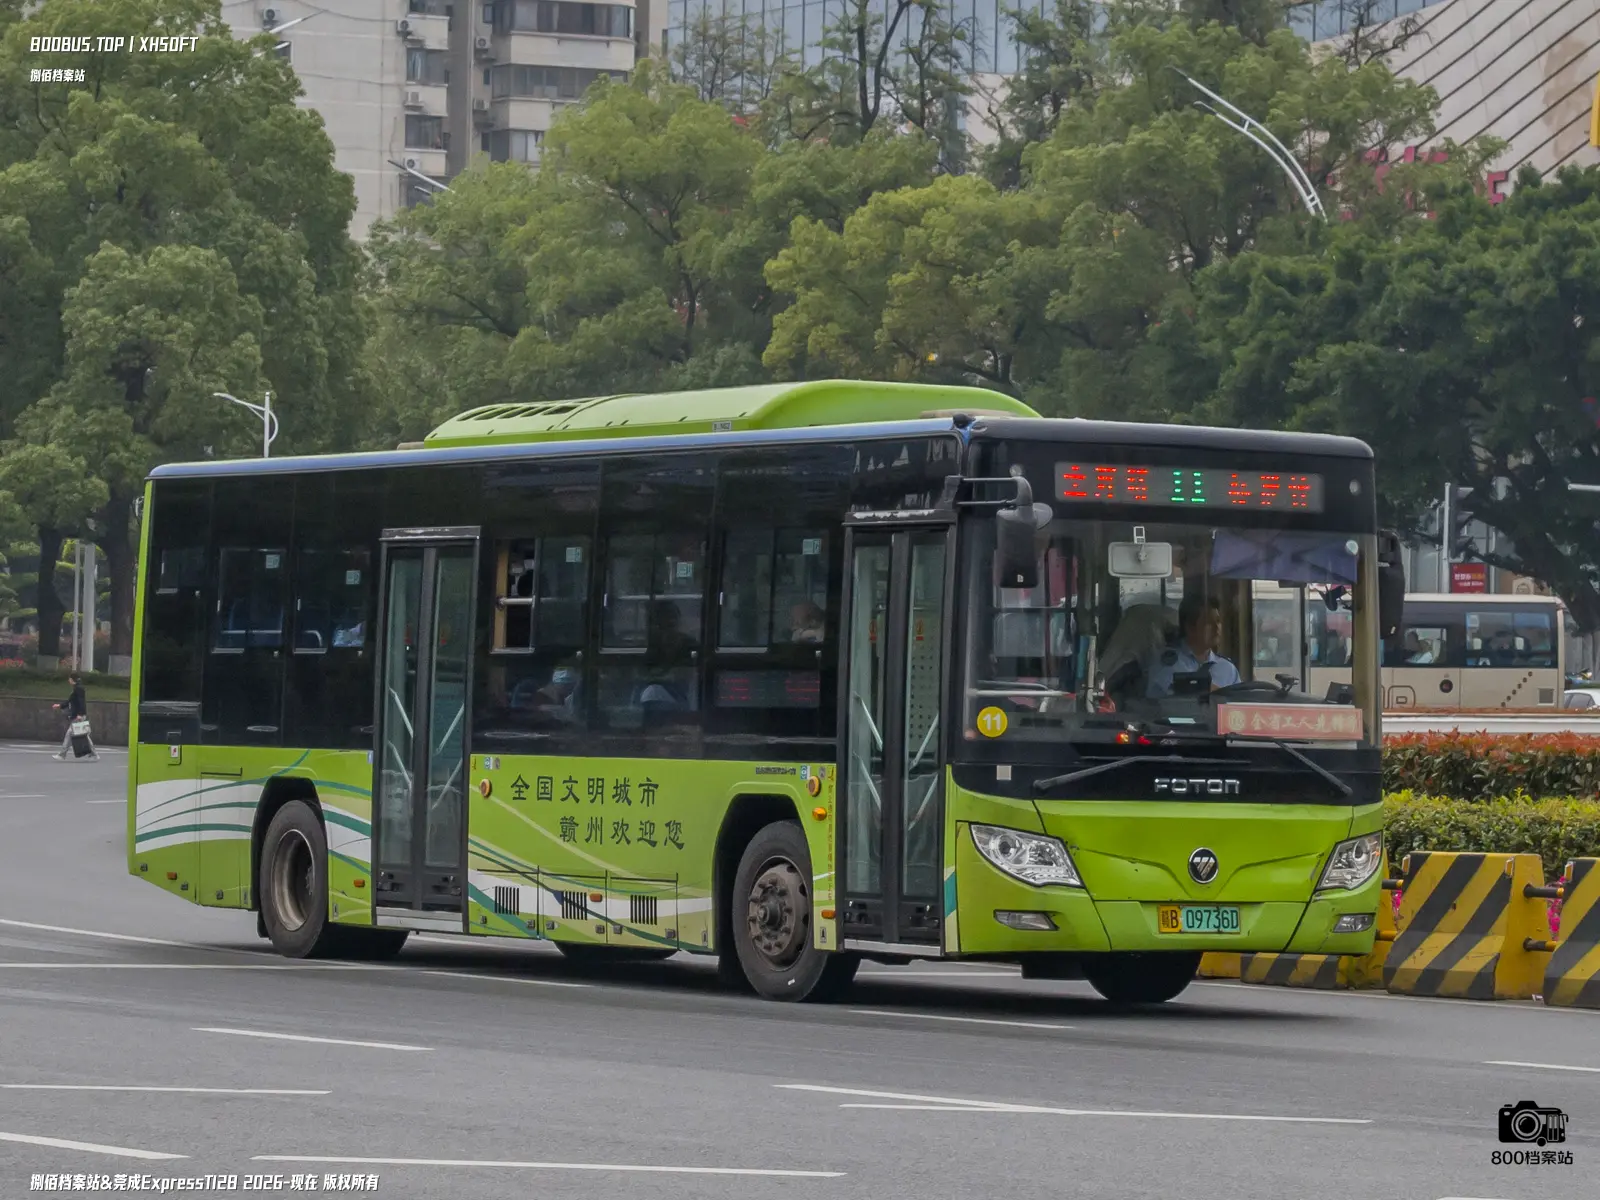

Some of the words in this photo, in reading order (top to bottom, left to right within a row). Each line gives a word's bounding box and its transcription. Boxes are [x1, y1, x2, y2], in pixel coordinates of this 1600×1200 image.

[983, 713, 1002, 731] 11
[510, 774, 659, 807] 全国文明城市
[1154, 778, 1240, 794] FOTON
[559, 815, 685, 850] 赣州欢迎您
